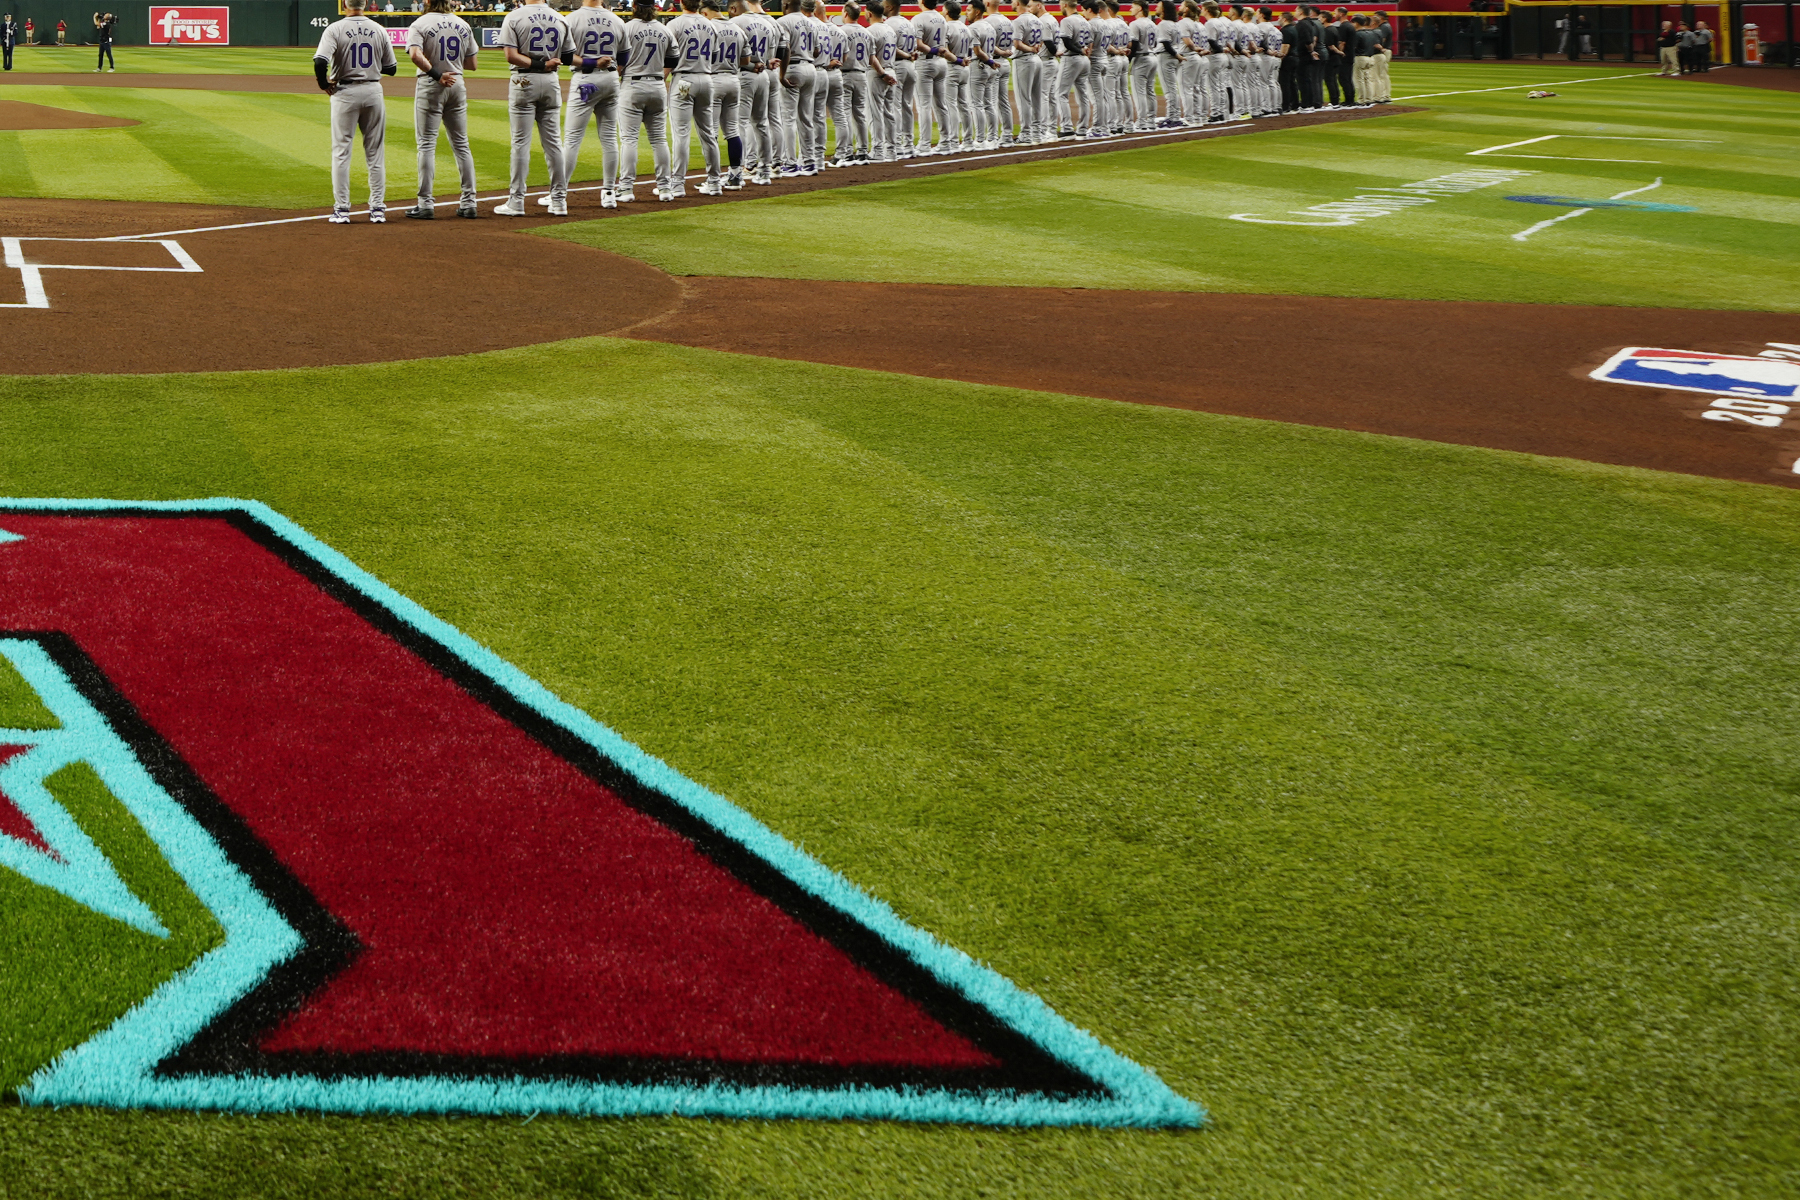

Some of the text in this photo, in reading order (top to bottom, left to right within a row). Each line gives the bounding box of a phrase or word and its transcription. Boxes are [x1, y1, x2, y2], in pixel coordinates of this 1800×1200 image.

[310, 17, 329, 28] 413
[528, 13, 557, 24] BRYANT
[587, 17, 613, 27] JONES
[346, 27, 376, 40] BLACK
[428, 21, 469, 40] BLACKMON
[529, 27, 559, 52] 23
[634, 28, 667, 43] RODGERS
[933, 27, 941, 46] 4
[1000, 31, 1013, 47] 25
[1028, 28, 1042, 45] 32
[439, 36, 460, 61] 19
[584, 31, 615, 55] 22
[686, 37, 711, 61] 24
[748, 35, 766, 58] 44
[800, 31, 812, 52] 31
[902, 34, 914, 52] 70
[960, 38, 969, 54] 11
[987, 37, 994, 54] 13
[350, 42, 373, 69] 10
[645, 42, 657, 66] 7
[719, 42, 737, 64] 14
[856, 42, 865, 61] 8
[883, 43, 895, 61] 67
[1702, 397, 1791, 428] 20
